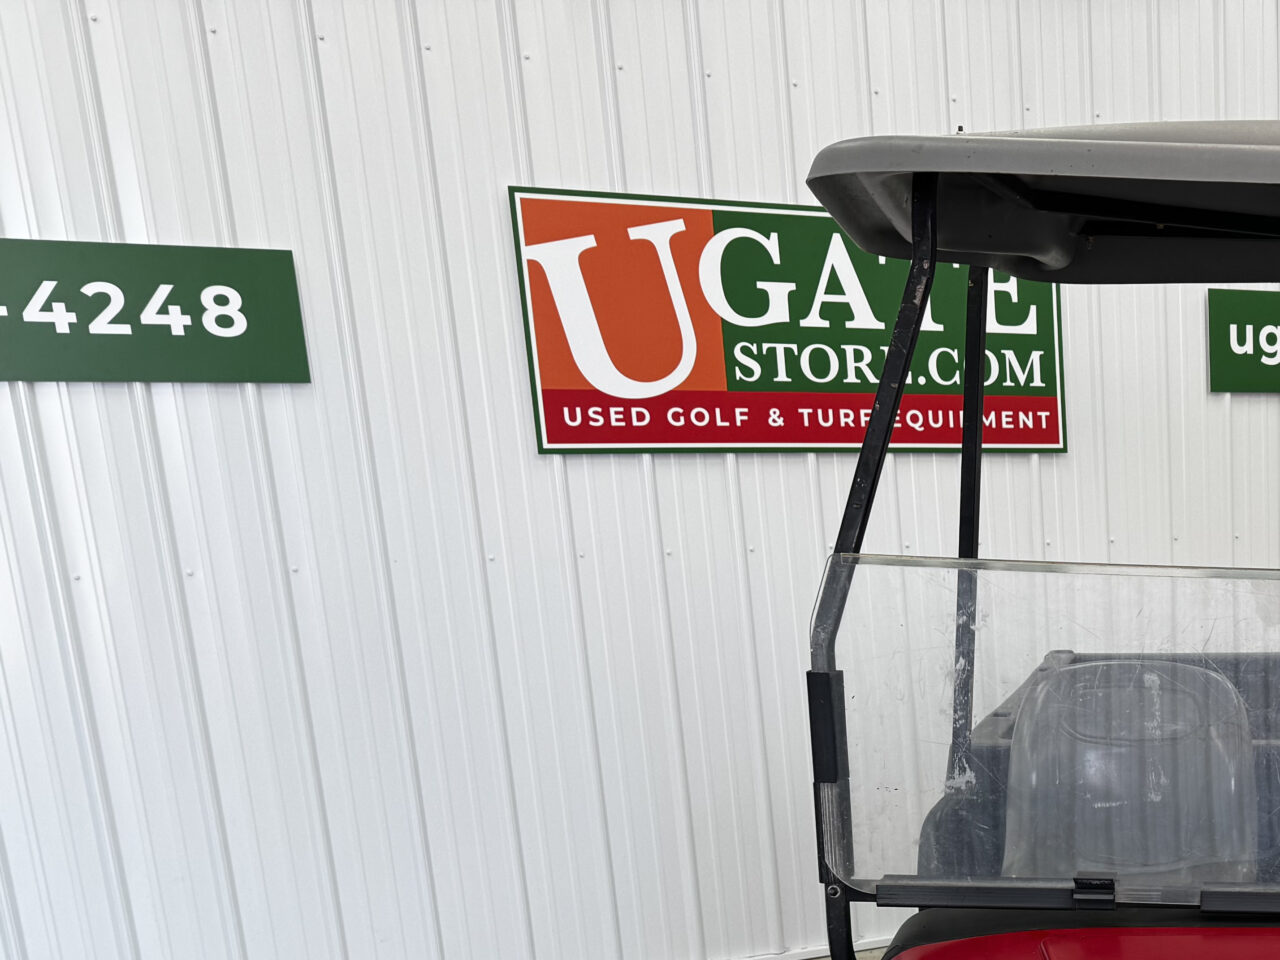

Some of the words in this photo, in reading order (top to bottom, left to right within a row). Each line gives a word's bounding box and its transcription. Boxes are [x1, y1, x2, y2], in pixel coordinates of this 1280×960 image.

[525, 217, 1038, 400] UGAE
[733, 341, 1046, 388] STOR.CM
[563, 405, 652, 428] USED
[666, 405, 750, 427] GOLF
[768, 406, 785, 427] &
[798, 408, 875, 427] TURF
[886, 409, 1051, 432] QUIMENT
